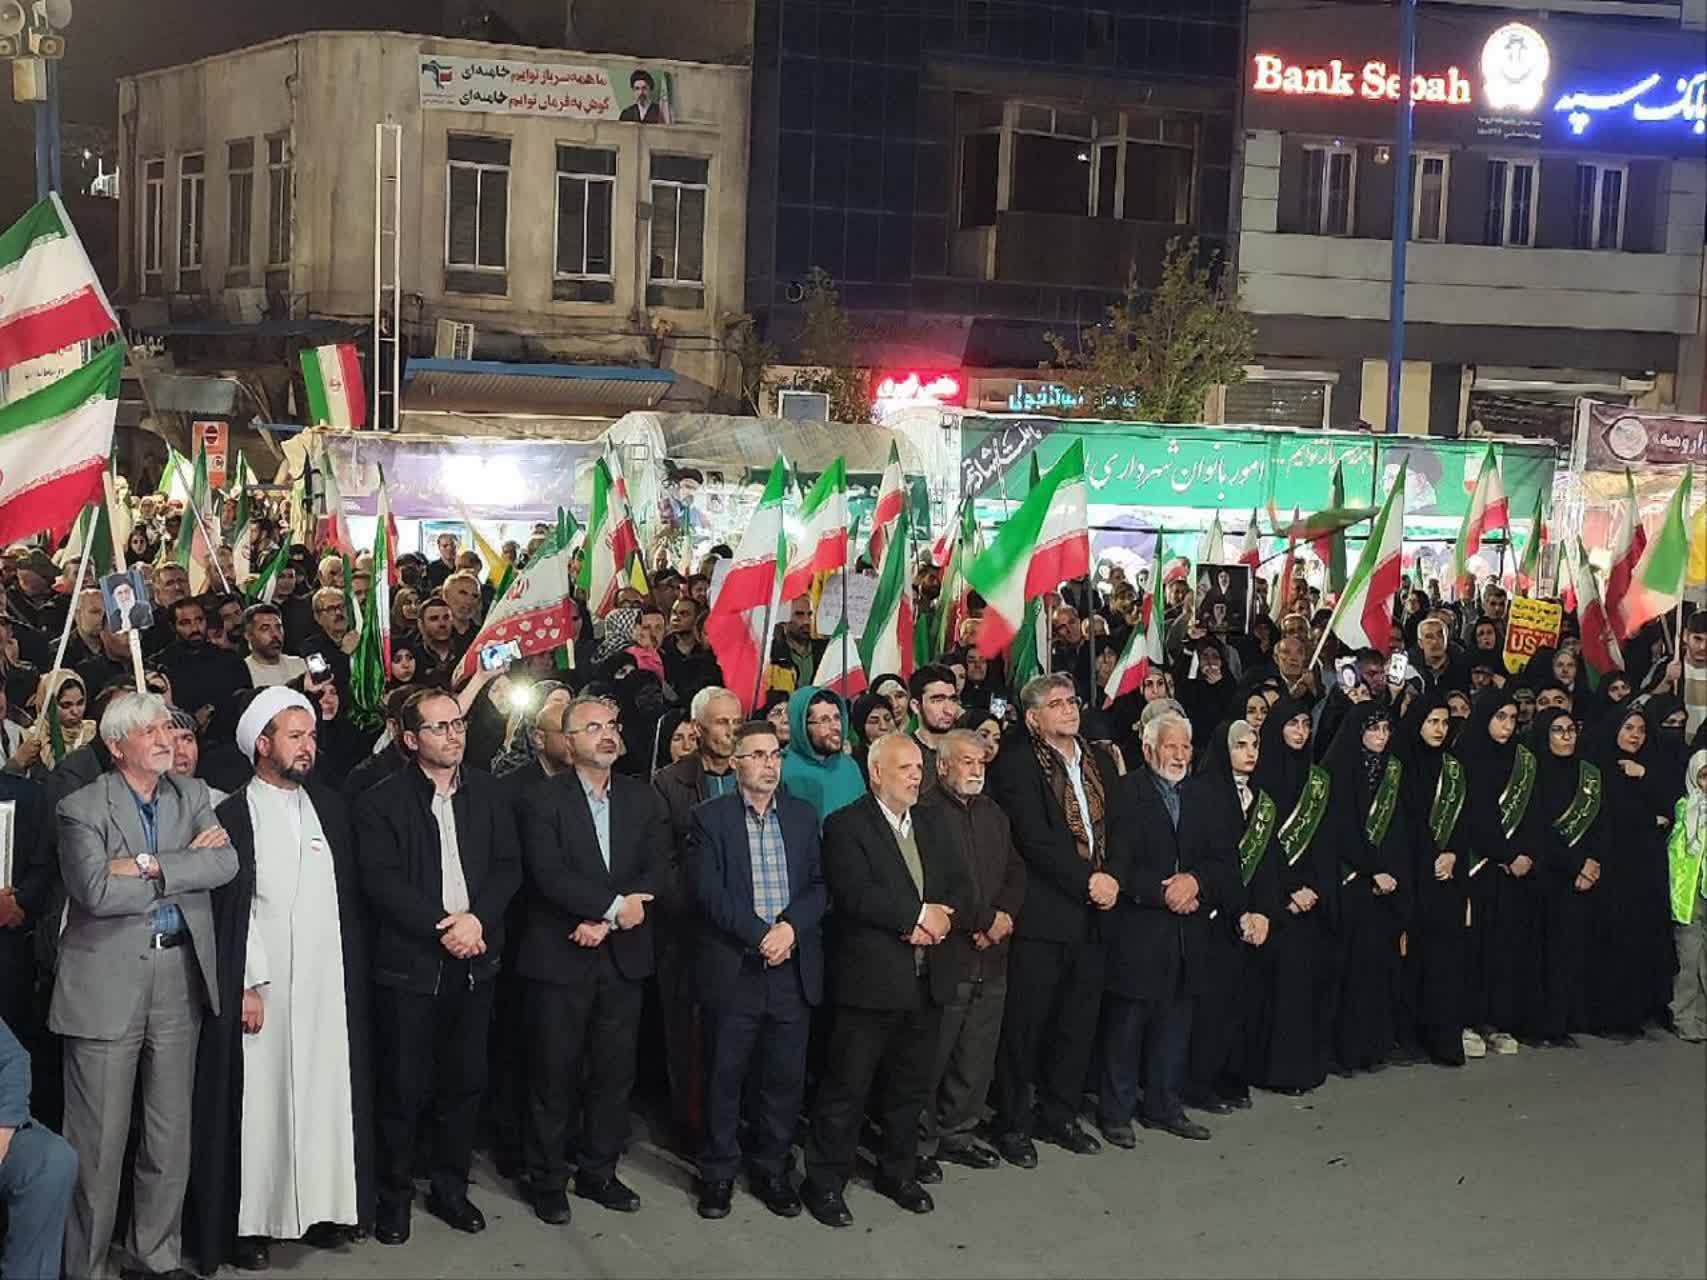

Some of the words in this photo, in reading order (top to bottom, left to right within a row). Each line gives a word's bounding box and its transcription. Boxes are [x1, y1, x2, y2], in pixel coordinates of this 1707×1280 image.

[538, 92, 570, 111] فرمان
[540, 68, 568, 86] سرباز
[1253, 54, 1354, 97] Bank
[1361, 61, 1472, 106] Sepah
[1553, 72, 1661, 135] سپه
[1088, 438, 1181, 491] شهرداری
[1170, 441, 1226, 502] بانوان
[1228, 458, 1266, 488] امور
